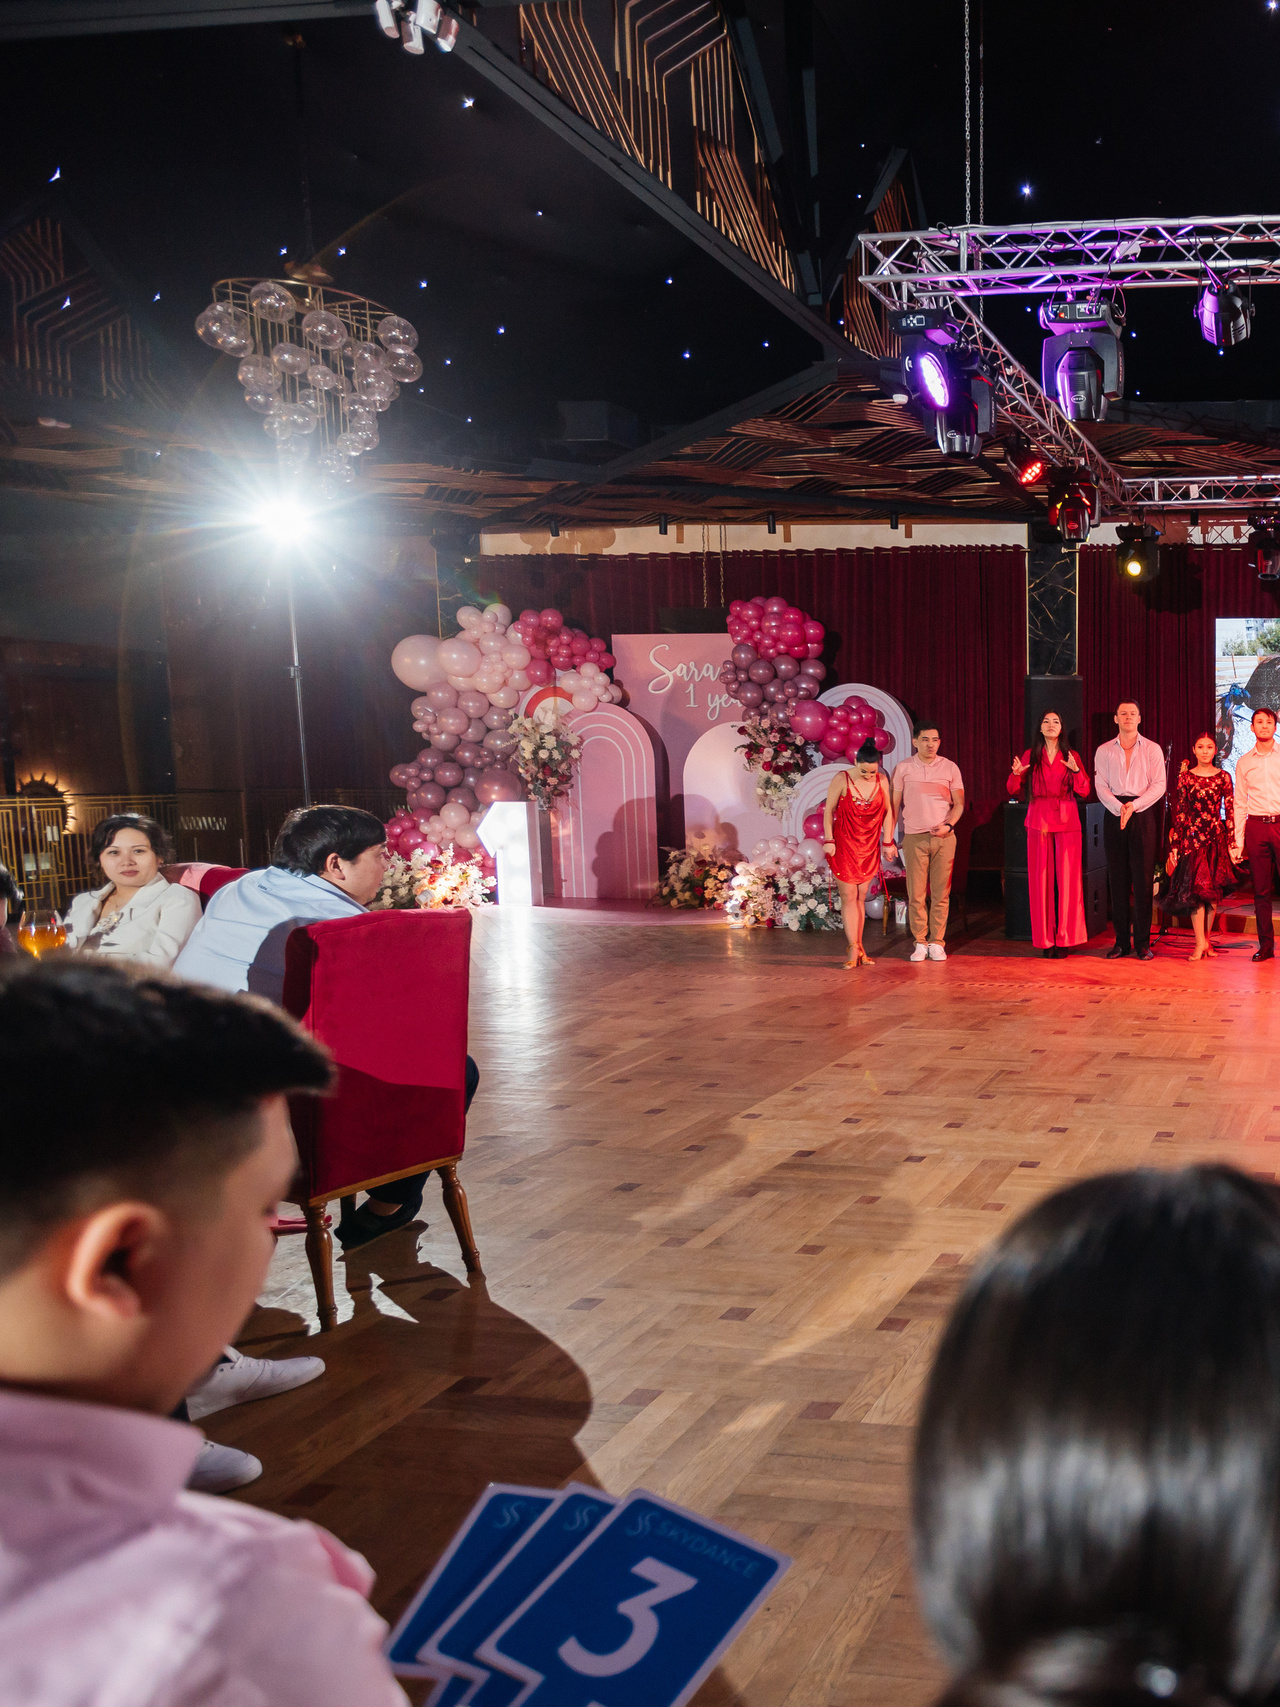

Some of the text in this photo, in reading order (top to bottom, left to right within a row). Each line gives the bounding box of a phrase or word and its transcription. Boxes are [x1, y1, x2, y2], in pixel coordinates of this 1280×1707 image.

[648, 644, 721, 694] Sara
[685, 683, 699, 707] 1
[656, 1519, 762, 1579] SKYDANCE
[557, 1556, 699, 1678] 3
